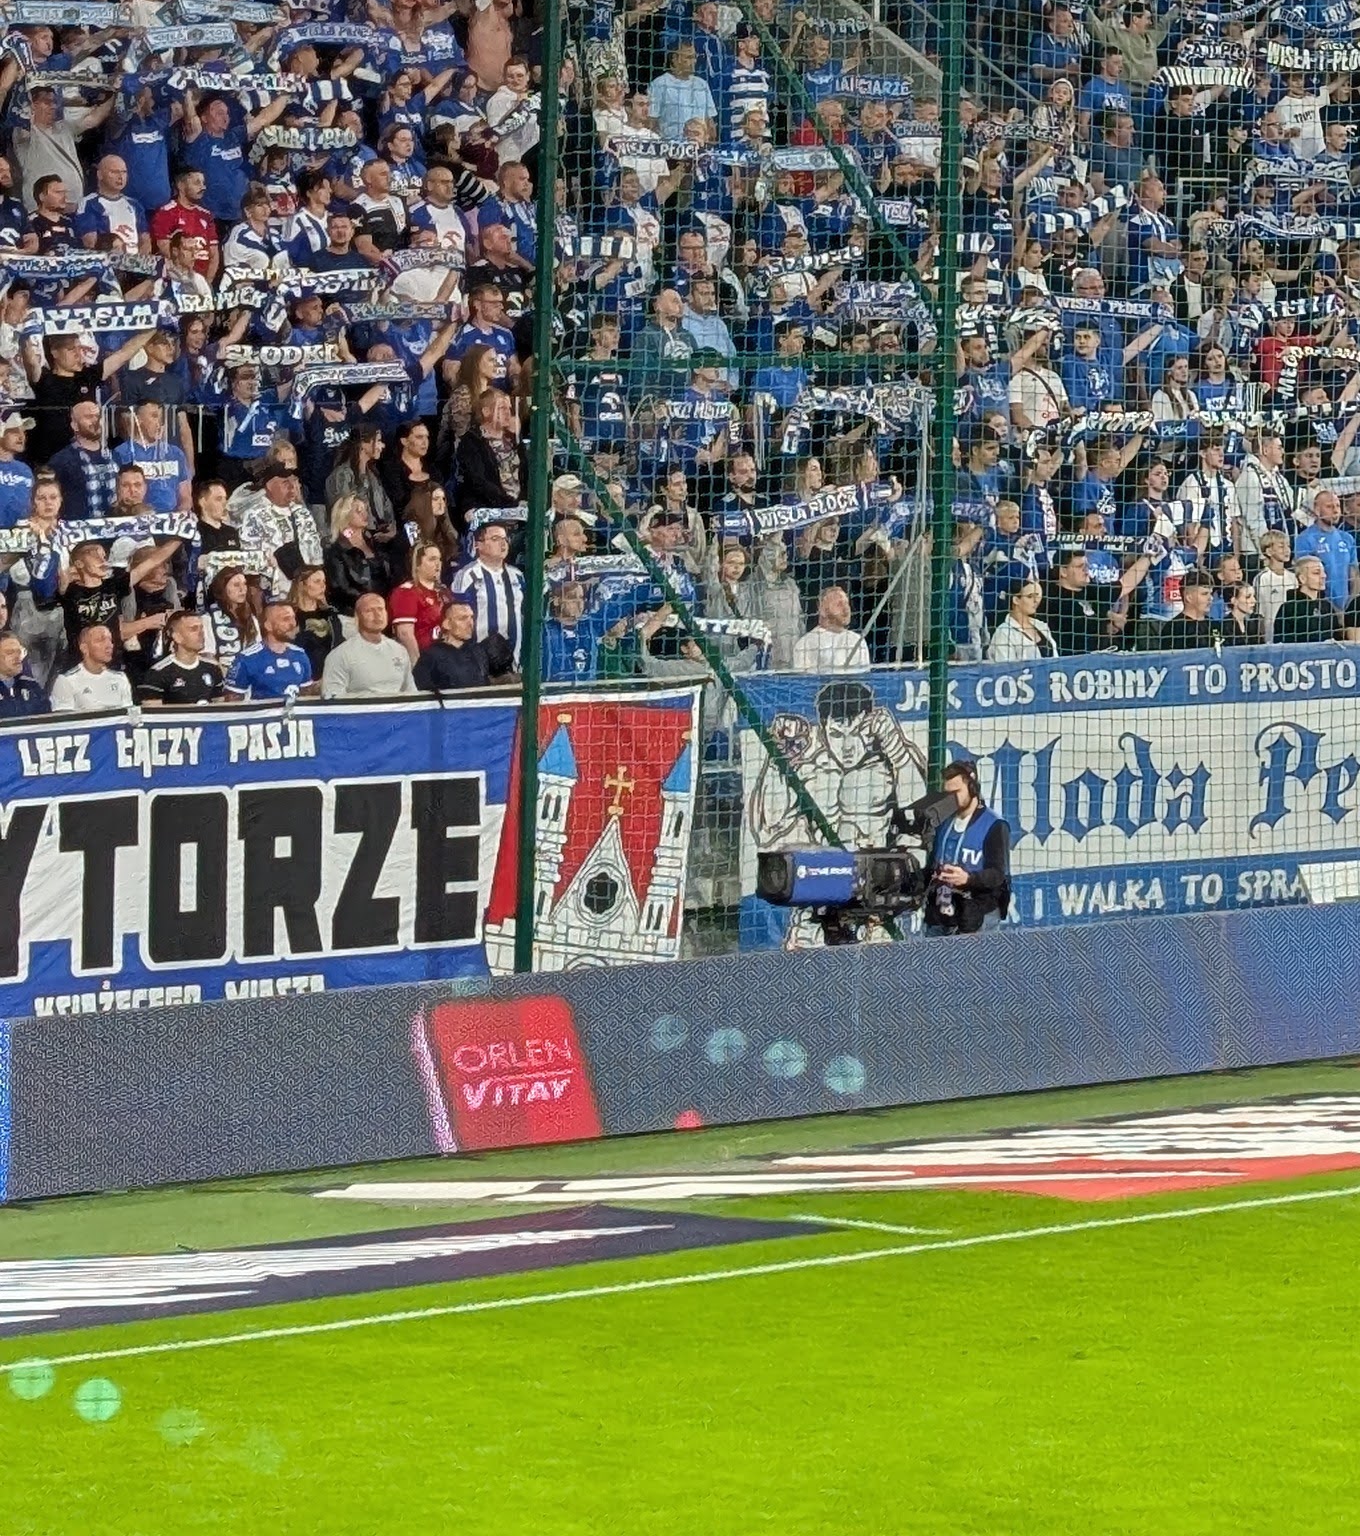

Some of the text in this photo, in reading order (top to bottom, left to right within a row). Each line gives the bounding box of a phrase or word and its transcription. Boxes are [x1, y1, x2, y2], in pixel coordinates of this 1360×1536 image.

[757, 486, 858, 532] WISŁA PŁOCK
[976, 669, 1035, 706] COŚ
[1050, 666, 1168, 703] ROBIMY
[1182, 665, 1227, 695] TO
[1239, 658, 1357, 693] PROSTO
[18, 719, 316, 777] LECZ ŁĄCZY PASJA
[961, 847, 983, 865] TV
[1183, 873, 1223, 905] TO
[453, 1038, 572, 1073] ORLEN
[463, 1078, 571, 1110] VITAY
